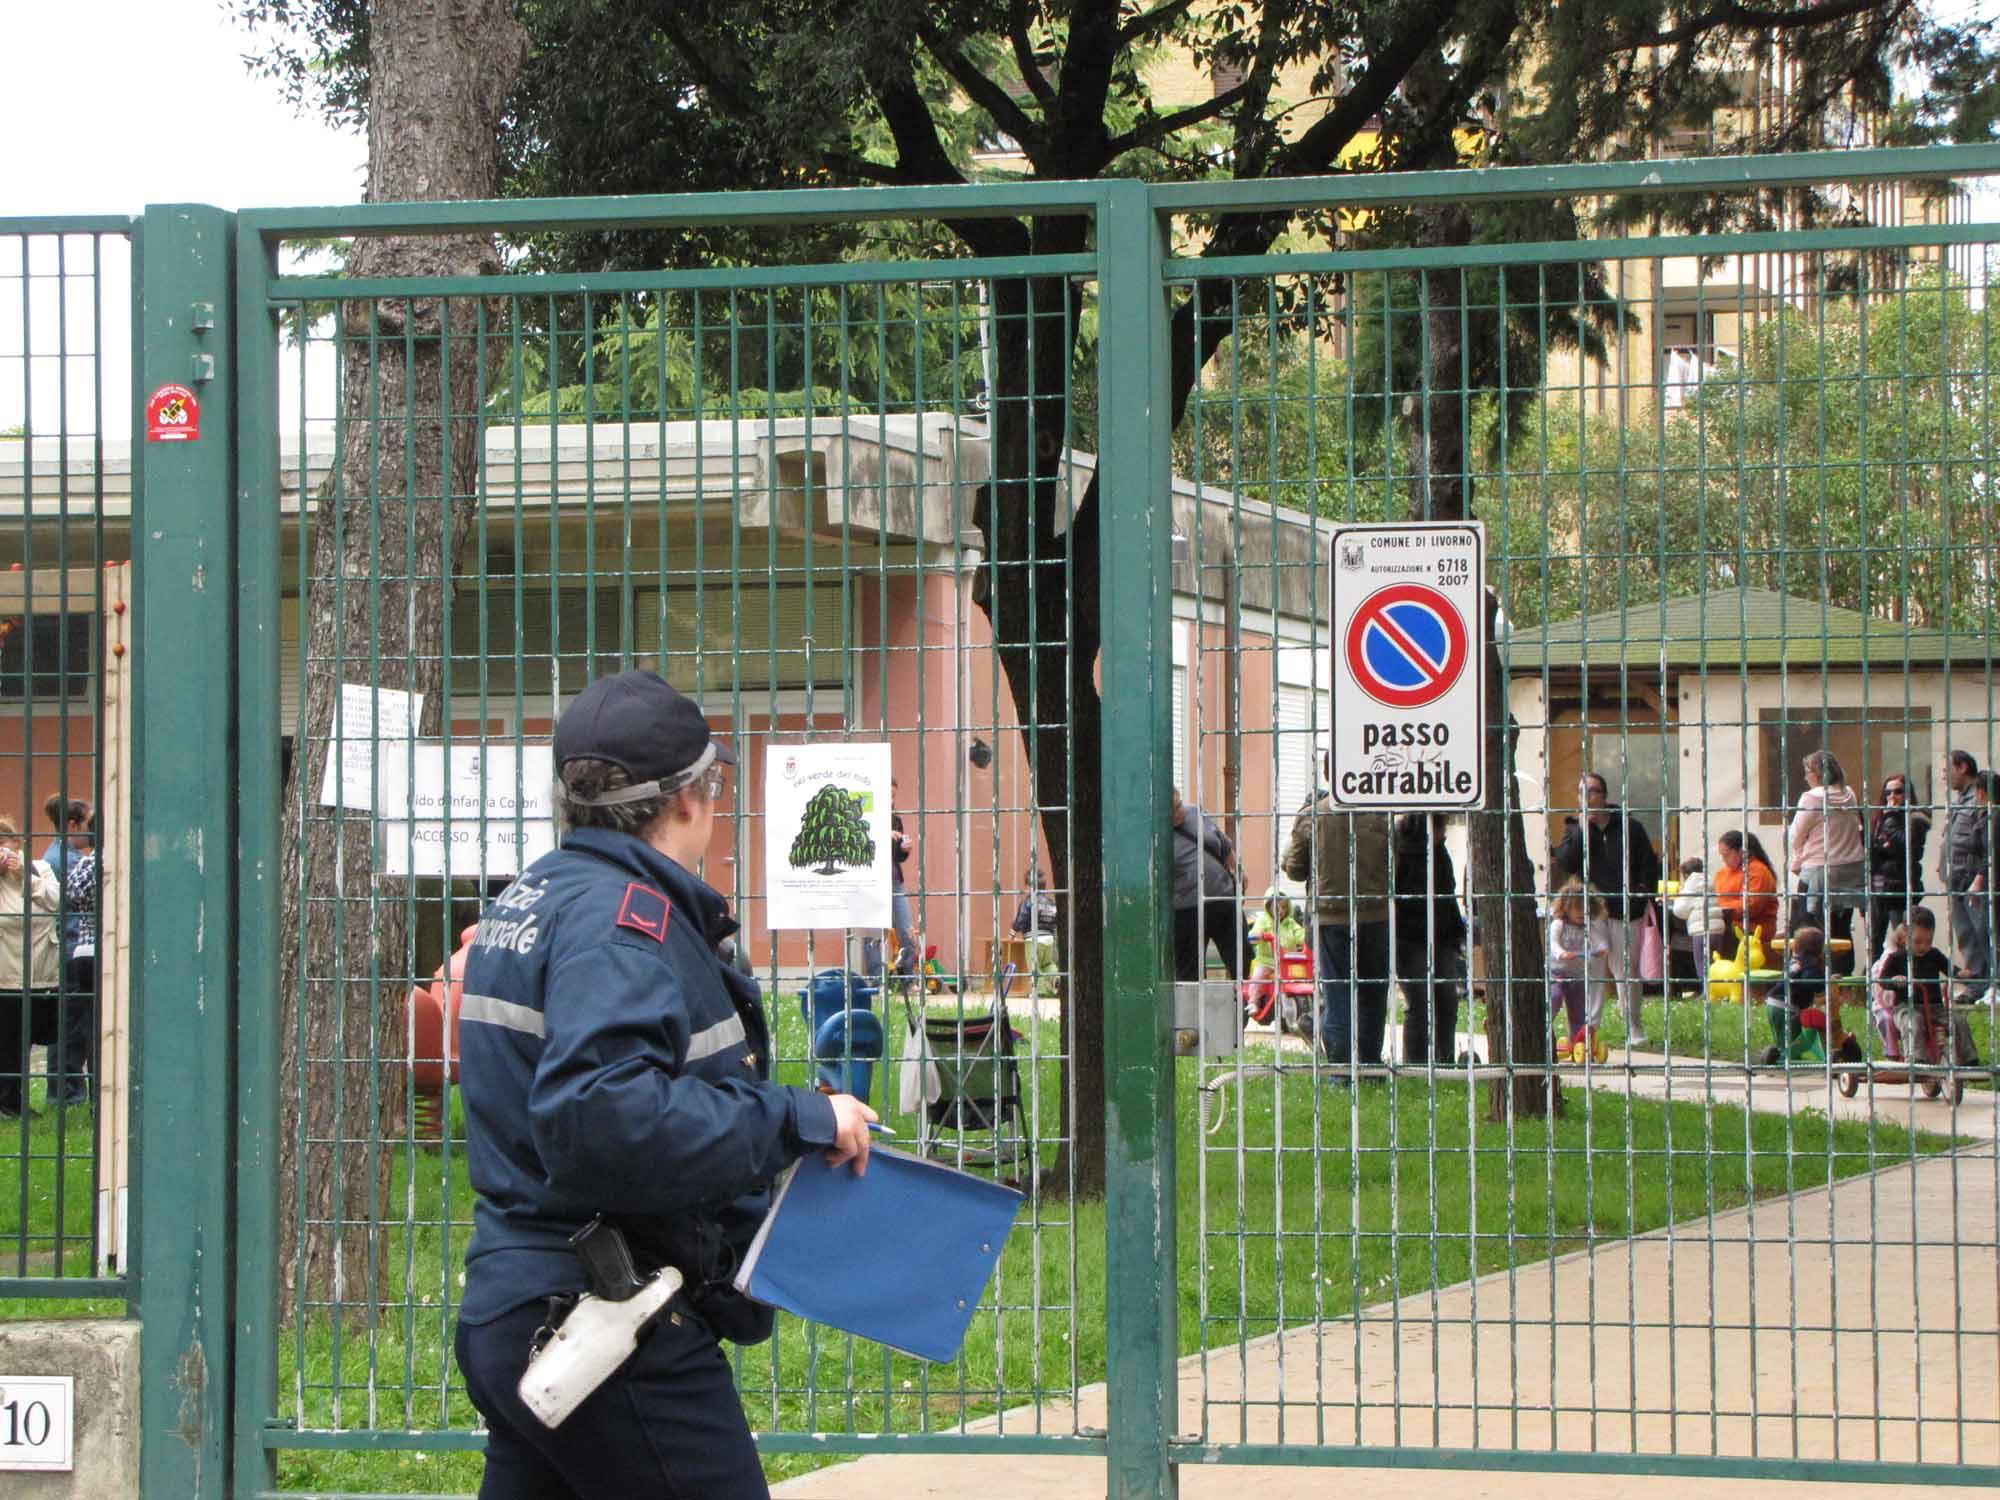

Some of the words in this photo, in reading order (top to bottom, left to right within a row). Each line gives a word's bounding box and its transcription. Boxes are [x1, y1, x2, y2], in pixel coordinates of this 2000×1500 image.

[1370, 536, 1411, 548] COMUNE
[1415, 536, 1426, 547] DI
[1431, 535, 1473, 546] LIVORNO
[1370, 564, 1424, 573] AUTORIZZAZIONE
[1437, 558, 1468, 573] 6718
[1437, 574, 1469, 586] 2007
[1363, 722, 1450, 755] passo
[1342, 760, 1473, 795] carrabile
[407, 793, 434, 807] ido
[414, 830, 469, 843] ACCESO
[3, 1400, 51, 1446] 10
